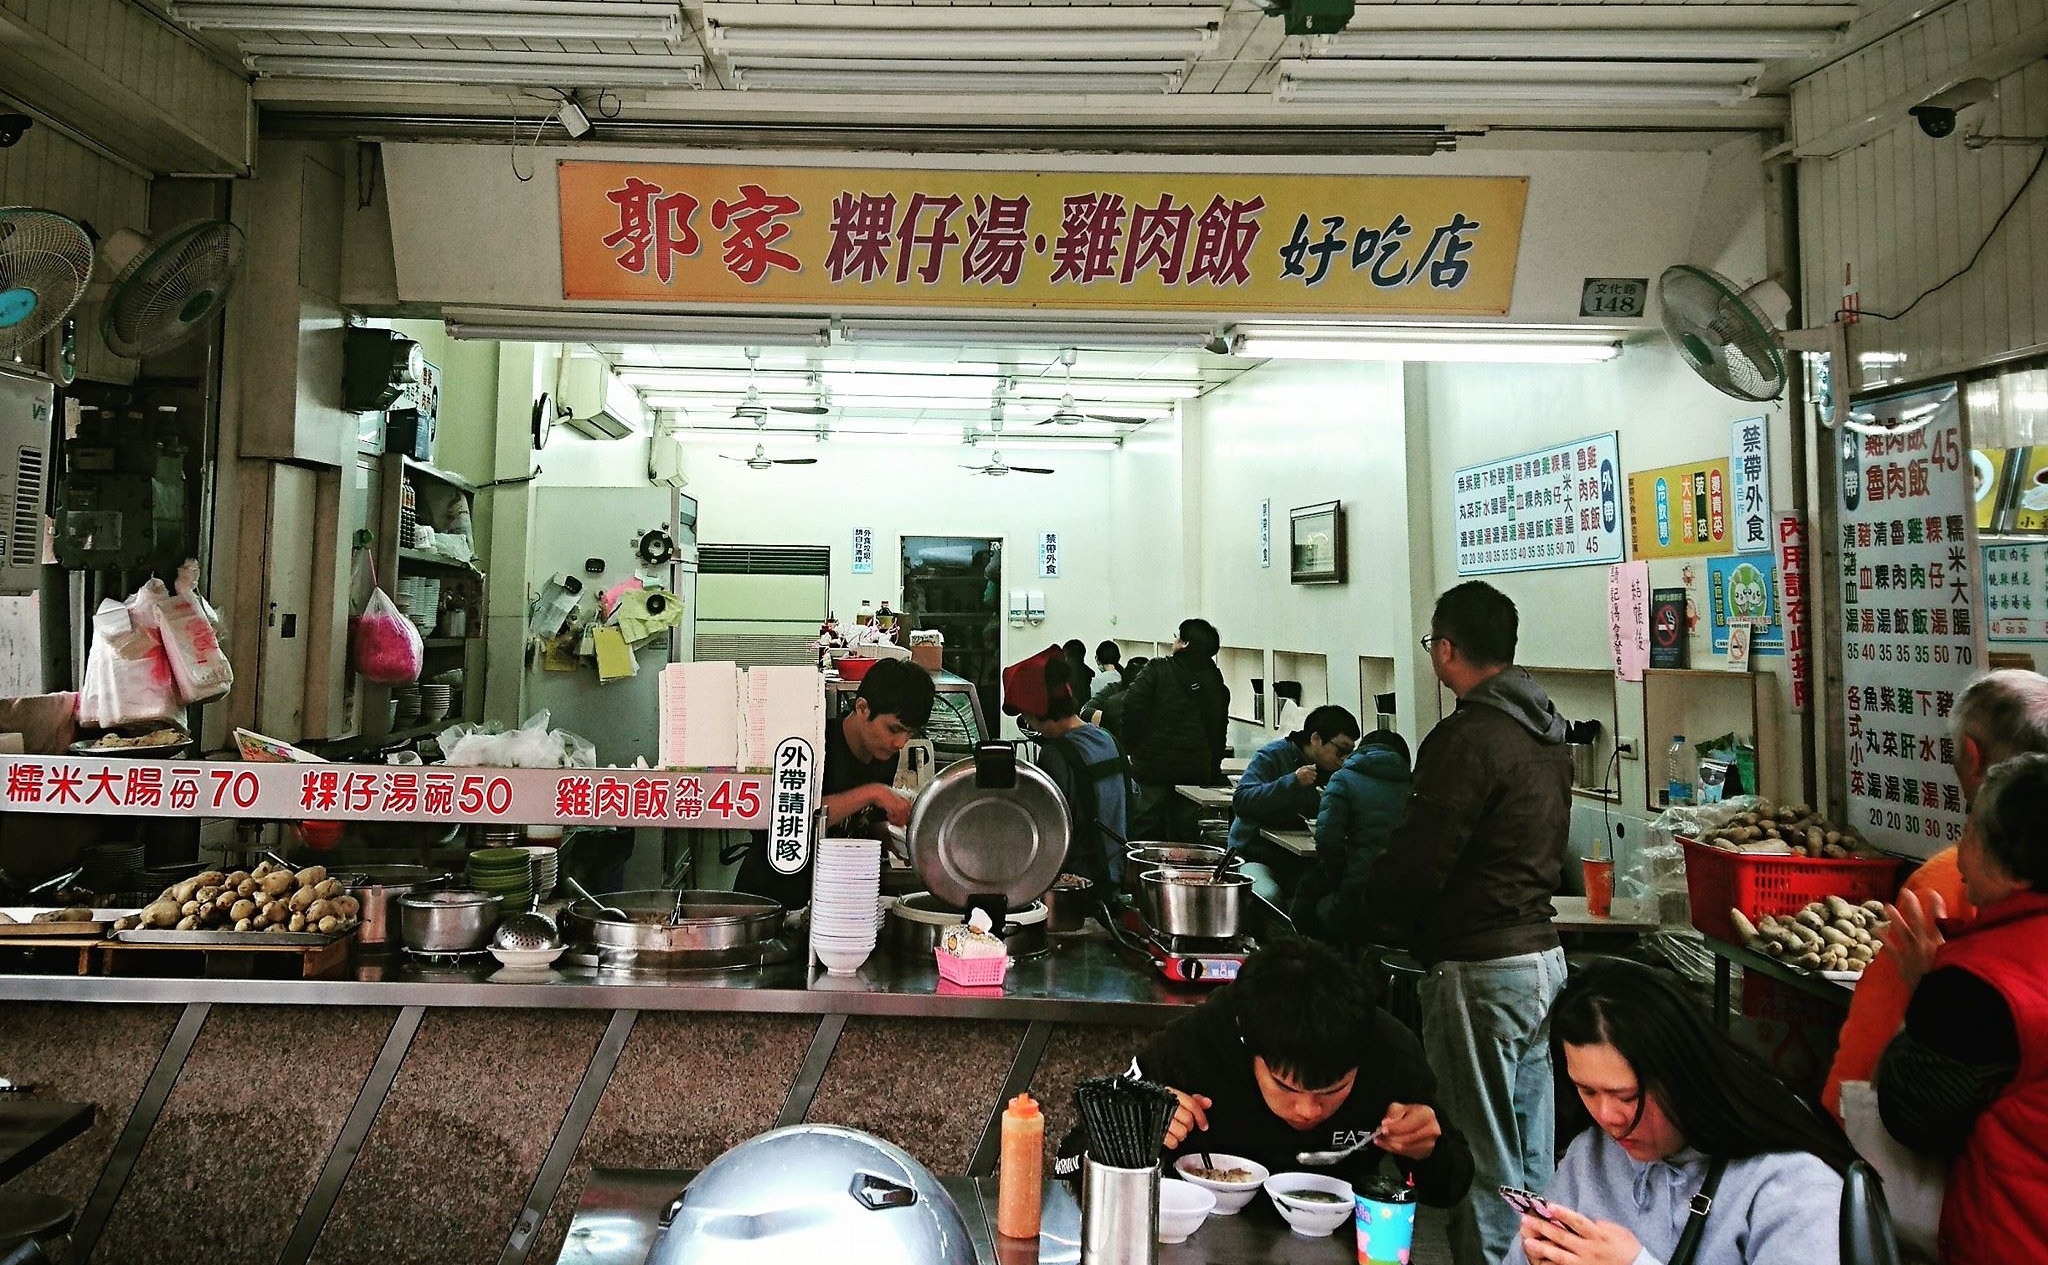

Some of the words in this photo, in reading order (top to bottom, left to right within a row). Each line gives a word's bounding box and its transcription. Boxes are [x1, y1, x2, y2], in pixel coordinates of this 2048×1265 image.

[602, 177, 800, 284] 郭家
[1279, 212, 1480, 288] 好吃店
[1594, 283, 1636, 294] 文化路
[1593, 297, 1634, 312] 148
[1931, 427, 1960, 473] 45
[1843, 432, 1858, 498] 外帶
[1743, 424, 1765, 543] 禁帶外食
[1866, 459, 1930, 502] 魯肉飯
[1602, 471, 1614, 522] 外帶
[1046, 533, 1057, 575] 禁帶外食
[1528, 546, 1536, 558] 35
[1536, 545, 1545, 557] 35
[1546, 544, 1555, 557] 35
[1556, 543, 1564, 556] 50
[1566, 541, 1575, 555] 70
[1586, 536, 1599, 554] 45
[1858, 522, 1875, 634] 豬血湯
[1874, 521, 1891, 634] 清粿湯
[1890, 520, 1909, 635] 魯肉飯
[1907, 518, 1928, 635] 雞肉飯
[1925, 516, 1948, 635] 粿仔湯
[1946, 515, 1970, 635] 糯米大腸
[1847, 643, 1859, 660] 35
[1862, 643, 1875, 660] 40
[1879, 644, 1892, 661] 35
[1896, 644, 1910, 662] 35
[1915, 645, 1929, 663] 35
[1934, 646, 1949, 663] 50
[1955, 646, 1972, 665] 70
[1848, 686, 1865, 796] 各式小菜
[1864, 686, 1882, 799] 魚丸湯
[1898, 688, 1920, 806] 豬肝湯
[1916, 690, 1939, 810] 下水湯
[775, 745, 807, 863] 外帶請排隊
[1870, 808, 1883, 826] 20
[1887, 811, 1901, 830] 20
[1905, 815, 1920, 834] 30
[1925, 819, 1940, 838] 30
